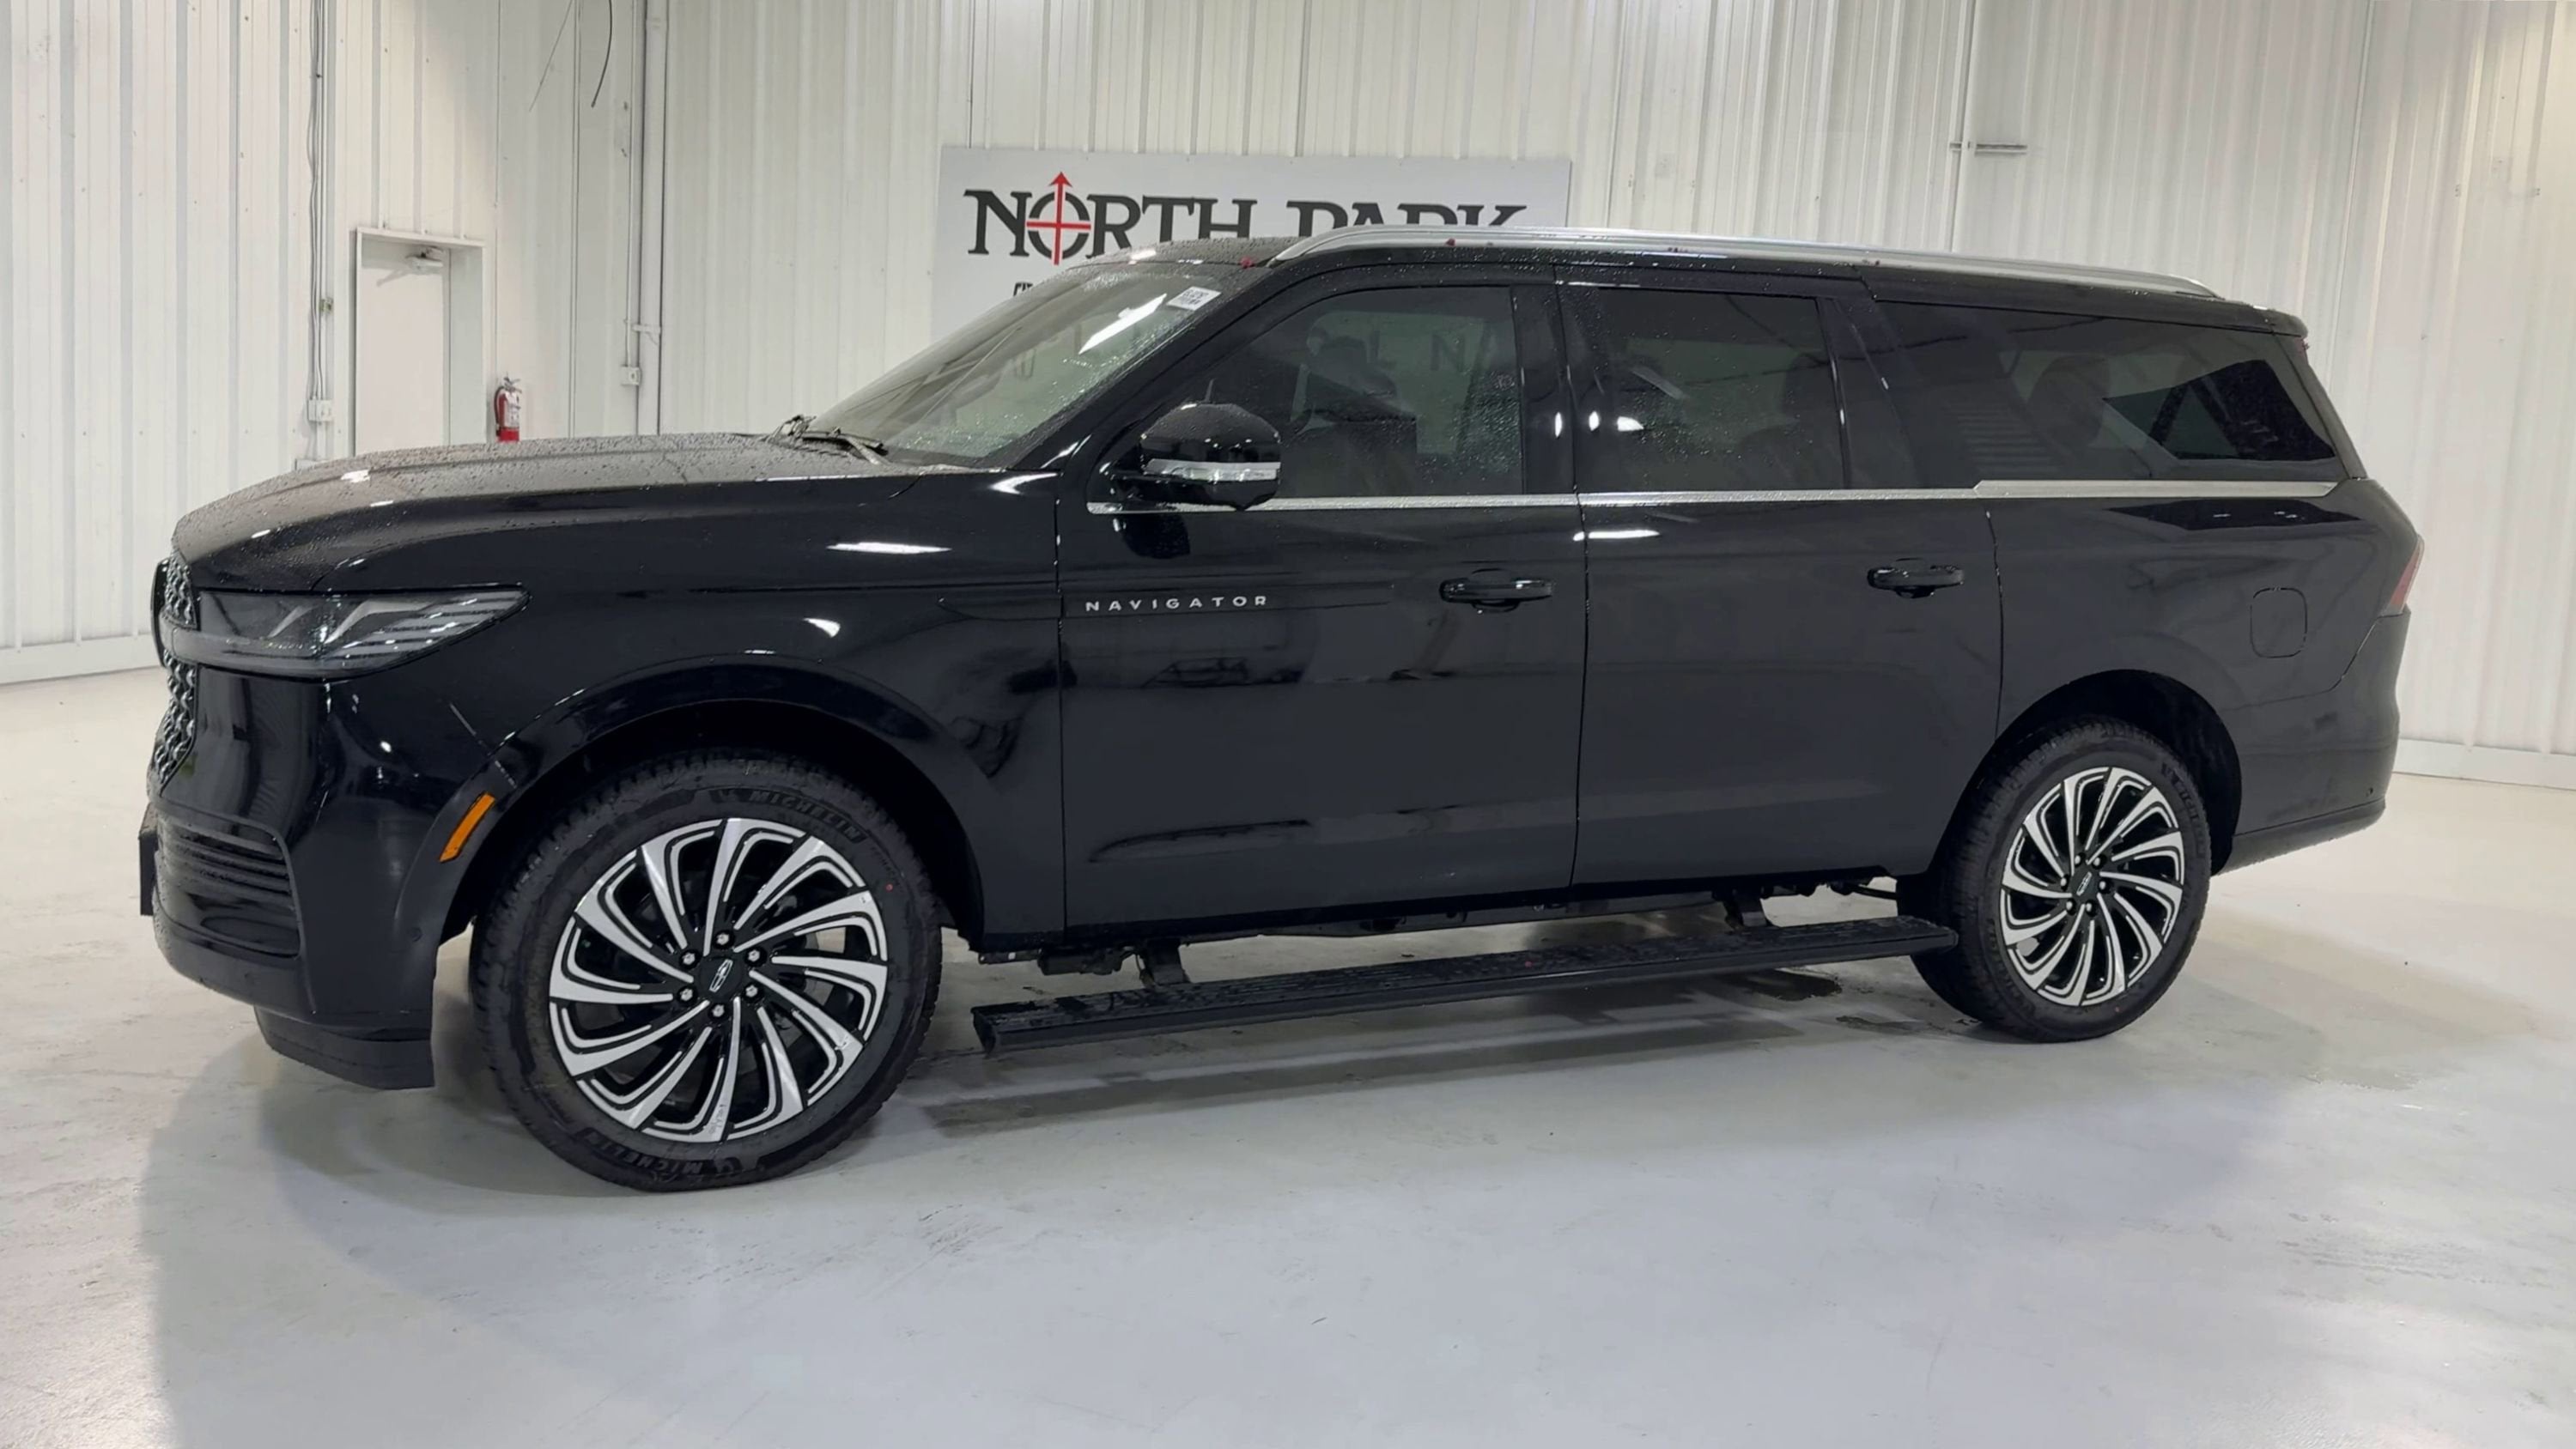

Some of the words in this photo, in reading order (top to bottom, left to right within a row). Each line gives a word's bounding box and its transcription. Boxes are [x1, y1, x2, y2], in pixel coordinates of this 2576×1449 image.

[963, 189, 1258, 260] NORTH
[1085, 596, 1267, 612] NAVIGATOR
[749, 789, 863, 842] MICHELIN
